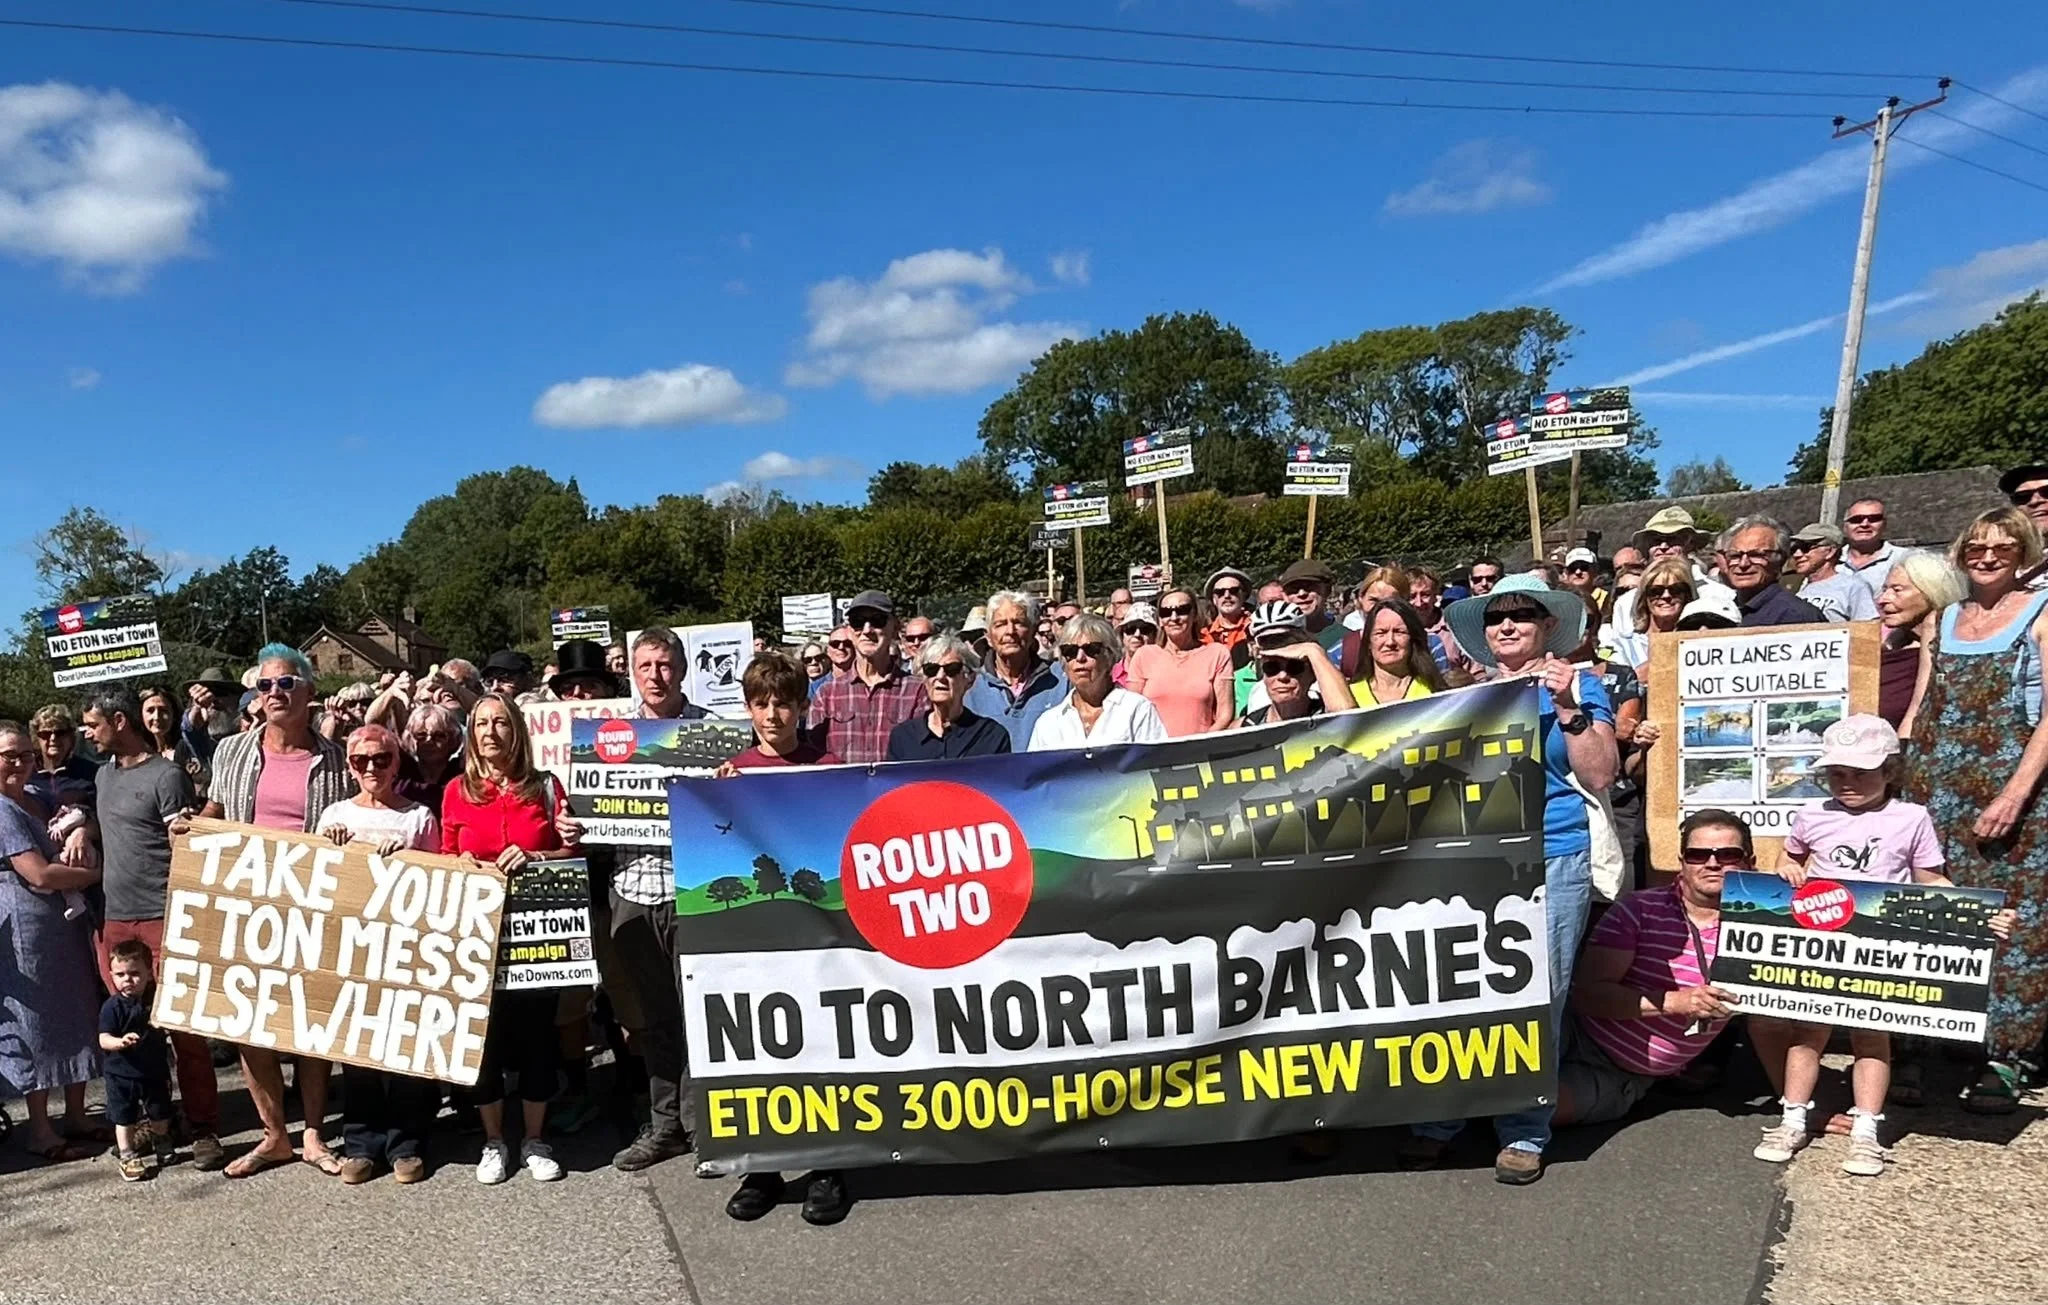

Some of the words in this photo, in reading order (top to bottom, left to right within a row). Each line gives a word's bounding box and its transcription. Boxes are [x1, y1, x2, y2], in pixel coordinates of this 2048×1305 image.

[1534, 418, 1548, 428] NO
[1551, 415, 1577, 427] ETON
[1601, 412, 1625, 422] TOWN
[51, 639, 68, 653] NO
[71, 634, 100, 650] ETON
[101, 632, 124, 646] NEW
[127, 628, 155, 641] TOWN
[1685, 648, 1724, 667] OUR
[1730, 643, 1793, 665] LANES
[1800, 640, 1844, 661] ARE
[1688, 676, 1725, 695] NOT
[1731, 671, 1828, 694] SUITABLE
[529, 710, 562, 736] NO
[597, 730, 634, 744] ROUND
[604, 743, 628, 756] TWO
[541, 743, 571, 766] ME
[575, 769, 600, 789] NO
[605, 770, 652, 790] ETON
[592, 797, 625, 815] JOIN
[627, 798, 651, 815] the
[1729, 810, 1781, 827] 000
[850, 821, 1013, 891] ROUND
[188, 831, 345, 912] TAKE
[362, 853, 506, 944] YOUR
[888, 880, 992, 938] TWO
[1792, 887, 1849, 915] ROUND
[538, 915, 586, 935] TOWN
[1807, 907, 1845, 927] TWO
[336, 916, 491, 1000] MESS
[1725, 928, 1764, 954] NO
[1770, 933, 1847, 963] ETON
[1853, 947, 1908, 969] NEW
[1912, 952, 1983, 977] TOWN
[703, 991, 804, 1063] NO
[819, 987, 914, 1060] TO
[933, 962, 1194, 1056] NORTH
[1216, 918, 1534, 1031] BARNES
[1748, 963, 1797, 986] JOIN
[1800, 969, 1836, 990] the
[1838, 976, 1943, 1004] campaign
[156, 956, 489, 1086] ELSEWHERE
[1738, 992, 1977, 1034] ntUrbaniseTheDowns.com
[707, 1083, 884, 1139] ETON'S
[899, 1054, 1227, 1131] 3000-HOUSE
[1238, 1039, 1364, 1102] NEW
[1374, 1020, 1541, 1087] TOWN
